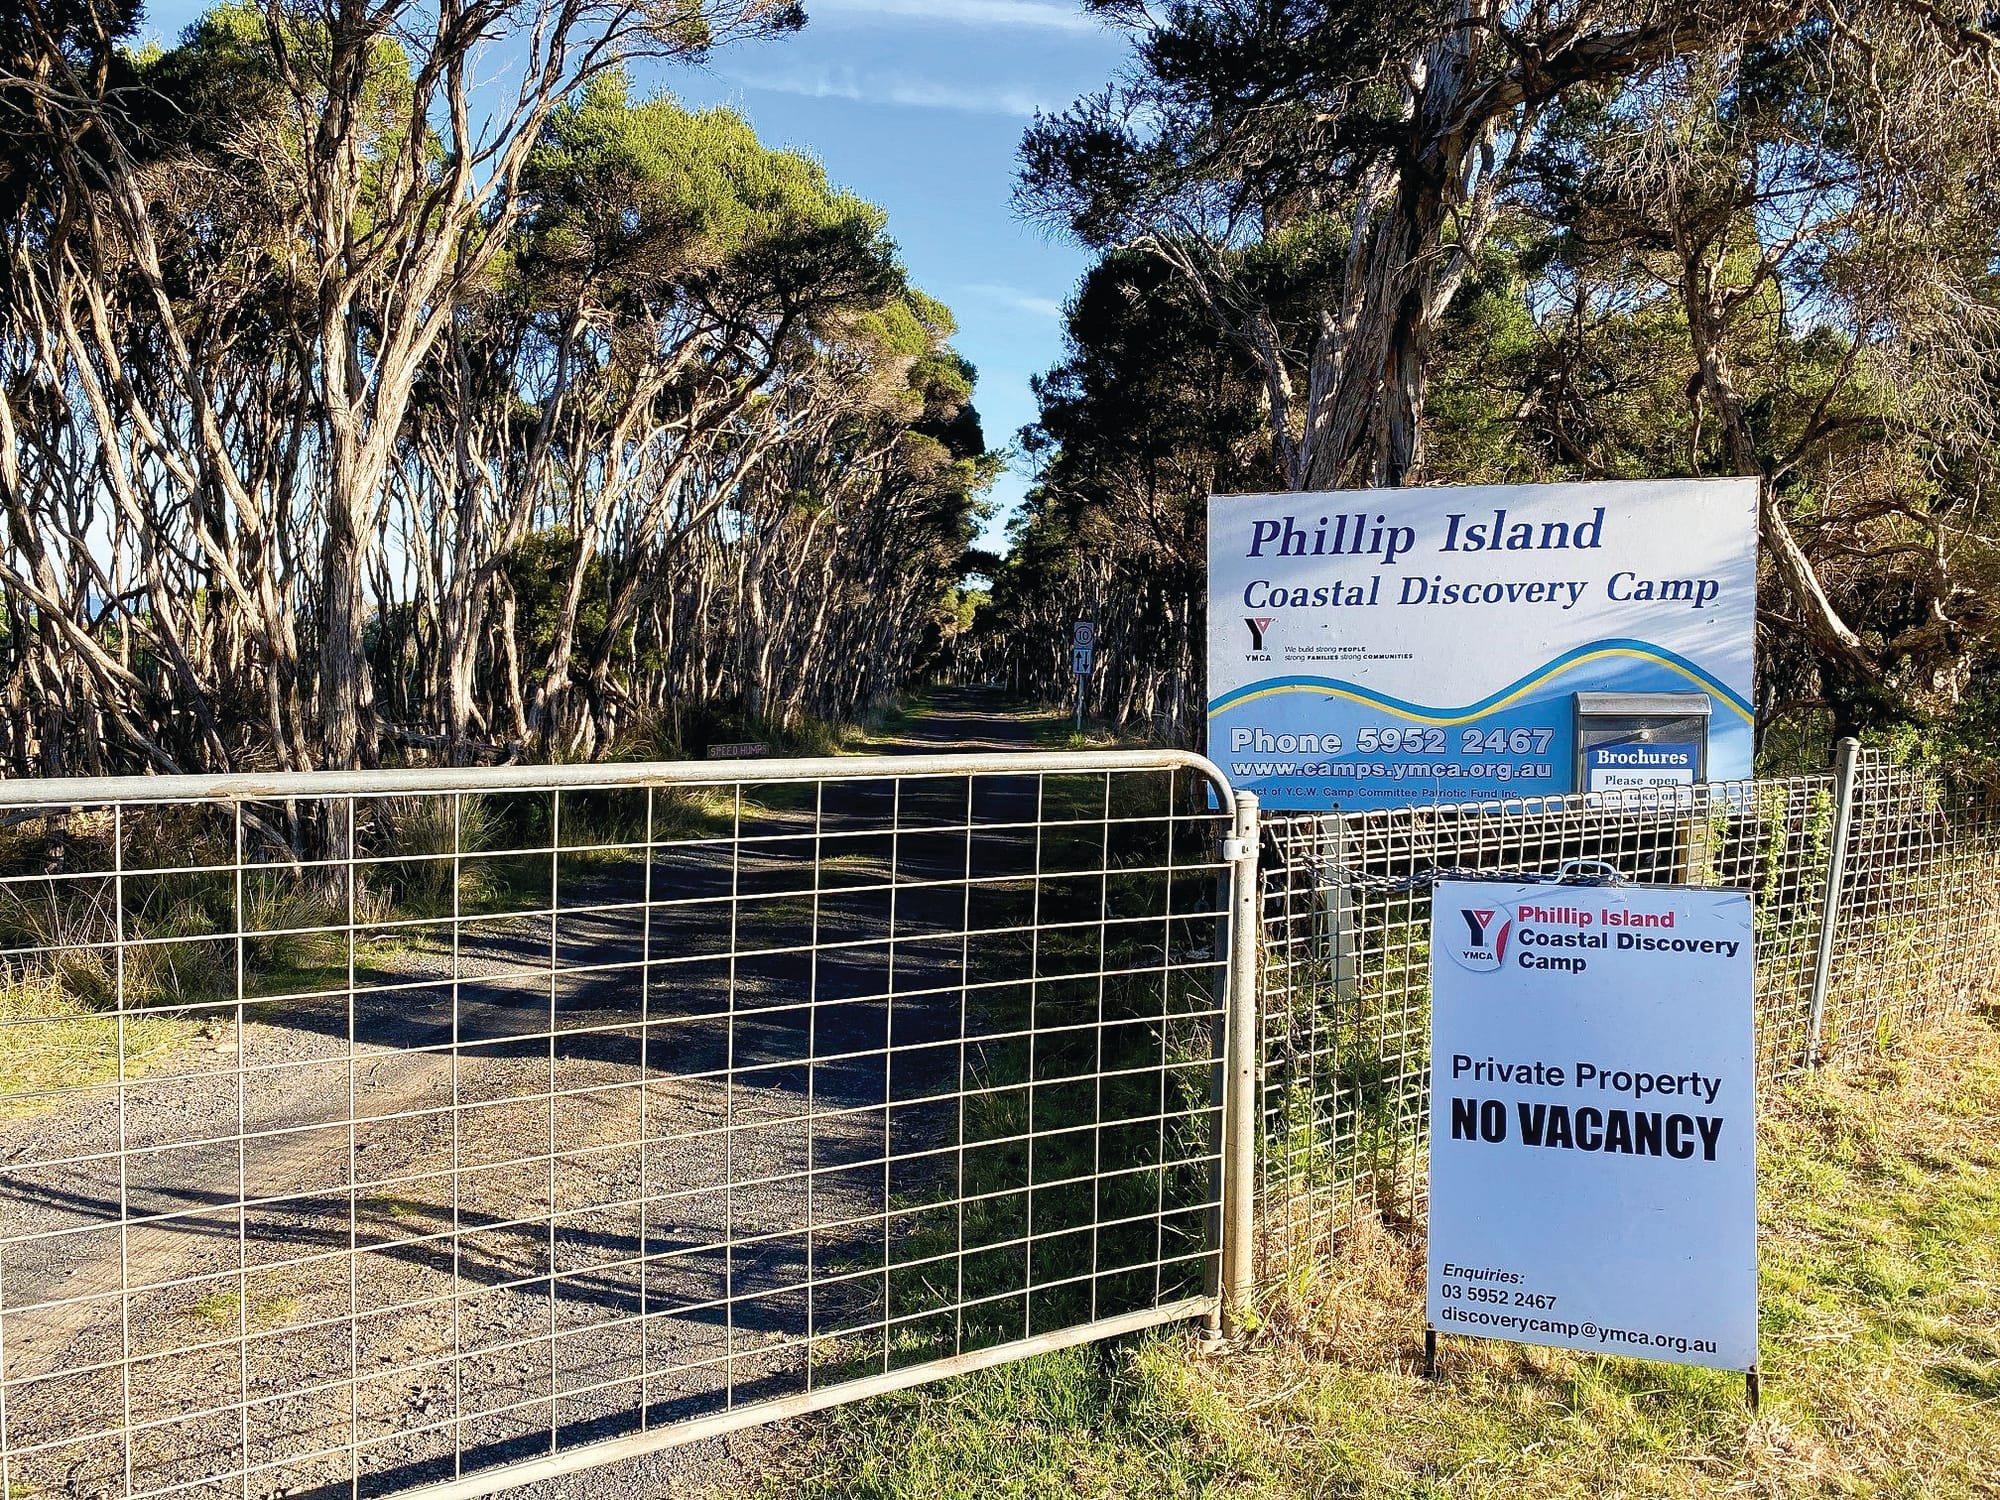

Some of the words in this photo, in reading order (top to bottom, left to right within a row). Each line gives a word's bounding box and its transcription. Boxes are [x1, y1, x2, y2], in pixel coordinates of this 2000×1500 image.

[1246, 513, 1416, 565] Phillip
[1439, 507, 1606, 552] Island
[1243, 575, 1381, 608] Coastal
[1397, 575, 1588, 609] Discovery
[1607, 572, 1720, 608] Camp
[710, 746, 738, 757] SPEED
[740, 744, 767, 755] HUMPS
[1230, 728, 1342, 753] Phone
[1356, 728, 1447, 753] 5952
[1461, 728, 1554, 754] 2467
[1597, 749, 1688, 764] Brochures
[1231, 762, 1552, 781] www.camps.ymca.org.au
[1605, 775, 1644, 785] Please
[1271, 787, 1281, 796] of
[1323, 788, 1354, 798] Camp
[1358, 788, 1418, 797] Committee
[1470, 789, 1498, 798] Fund
[1518, 906, 1593, 927] Phillip
[1601, 909, 1675, 928] Island
[1518, 929, 1608, 948] Coastal
[1617, 933, 1740, 957] Discovery
[1462, 951, 1494, 961] YMCA
[1518, 952, 1587, 974] Camp
[1452, 1054, 1565, 1086] Private
[1576, 1063, 1722, 1104] Property
[1451, 1097, 1507, 1143] NO
[1517, 1102, 1724, 1161] VACANCY
[1443, 1263, 1525, 1284] Enquiries:
[1441, 1284, 1462, 1299] 03
[1467, 1287, 1509, 1305] 5952
[1514, 1292, 1557, 1310] 2467
[1441, 1306, 1717, 1353] discoverycamp@ymca.org.au
